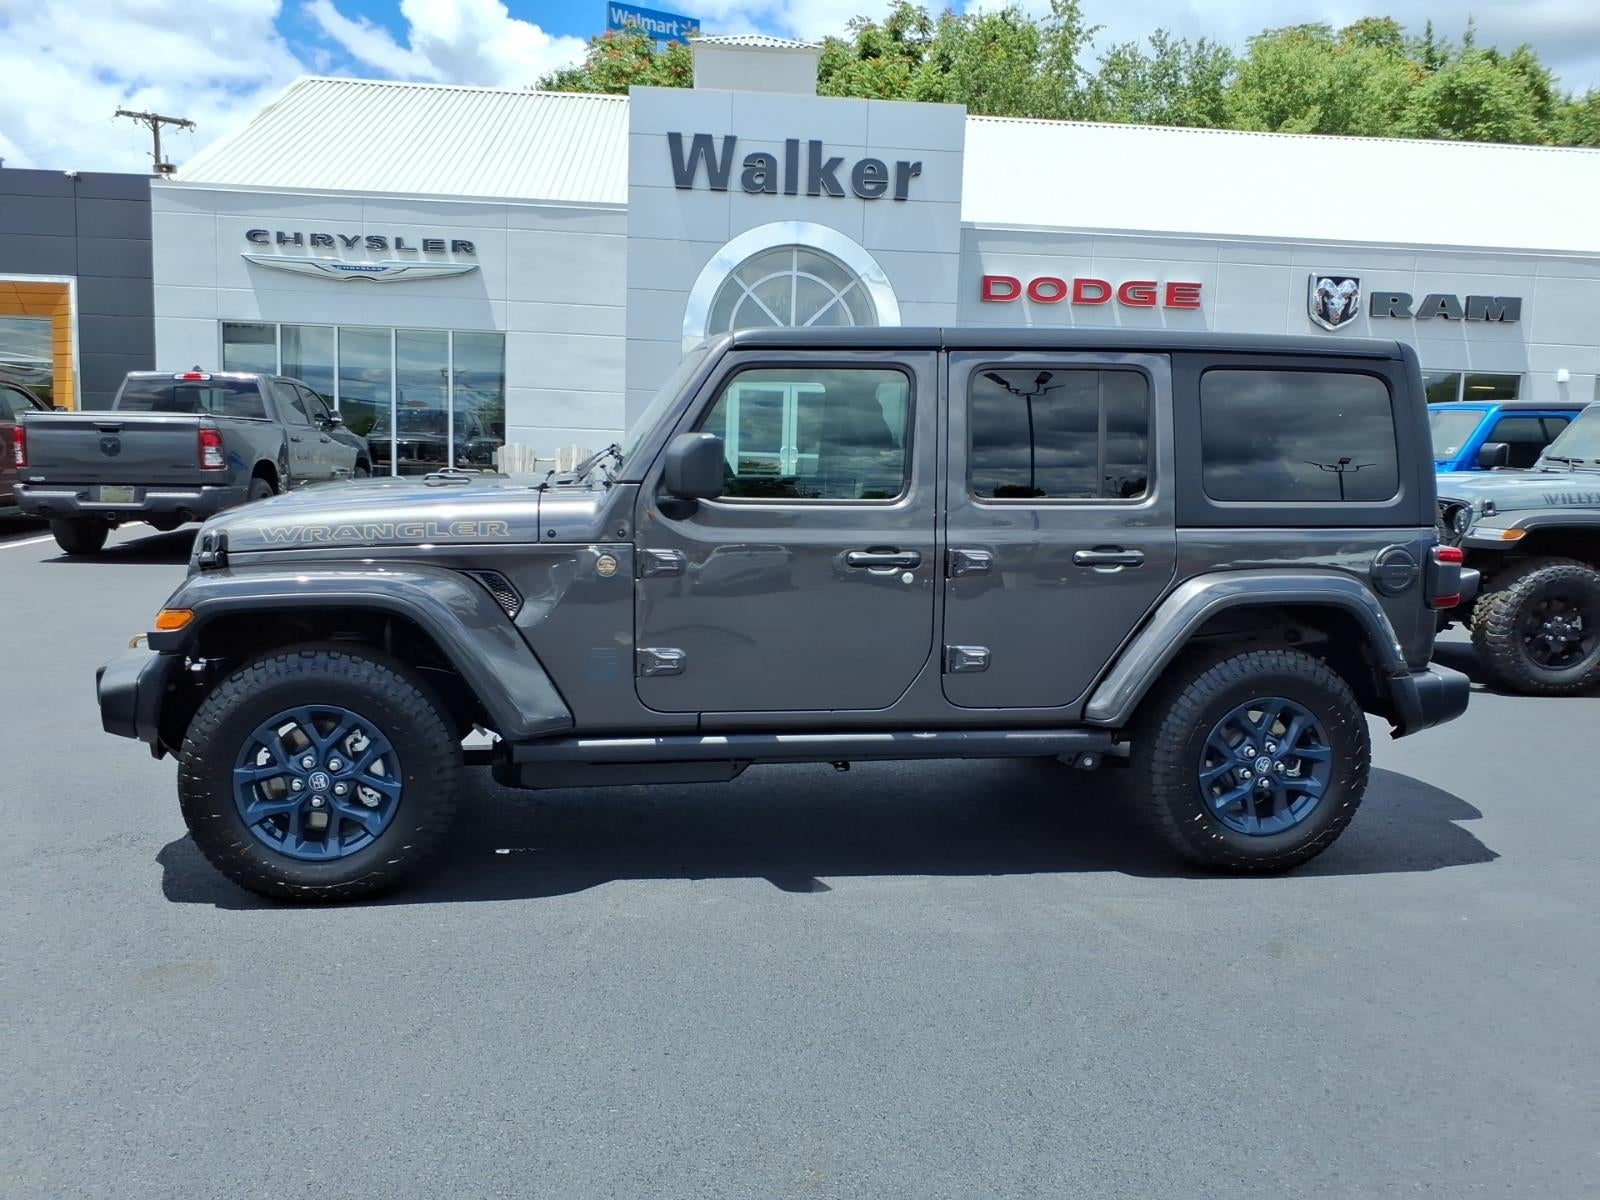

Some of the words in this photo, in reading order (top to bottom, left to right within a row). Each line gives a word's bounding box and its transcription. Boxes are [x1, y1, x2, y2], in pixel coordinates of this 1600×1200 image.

[610, 7, 678, 36] Walmart
[667, 131, 922, 201] Walker
[245, 229, 477, 254] CHRYSLER
[981, 275, 1202, 309] DODGE
[1370, 291, 1522, 322] RAM
[258, 520, 509, 543] WRANGLER
